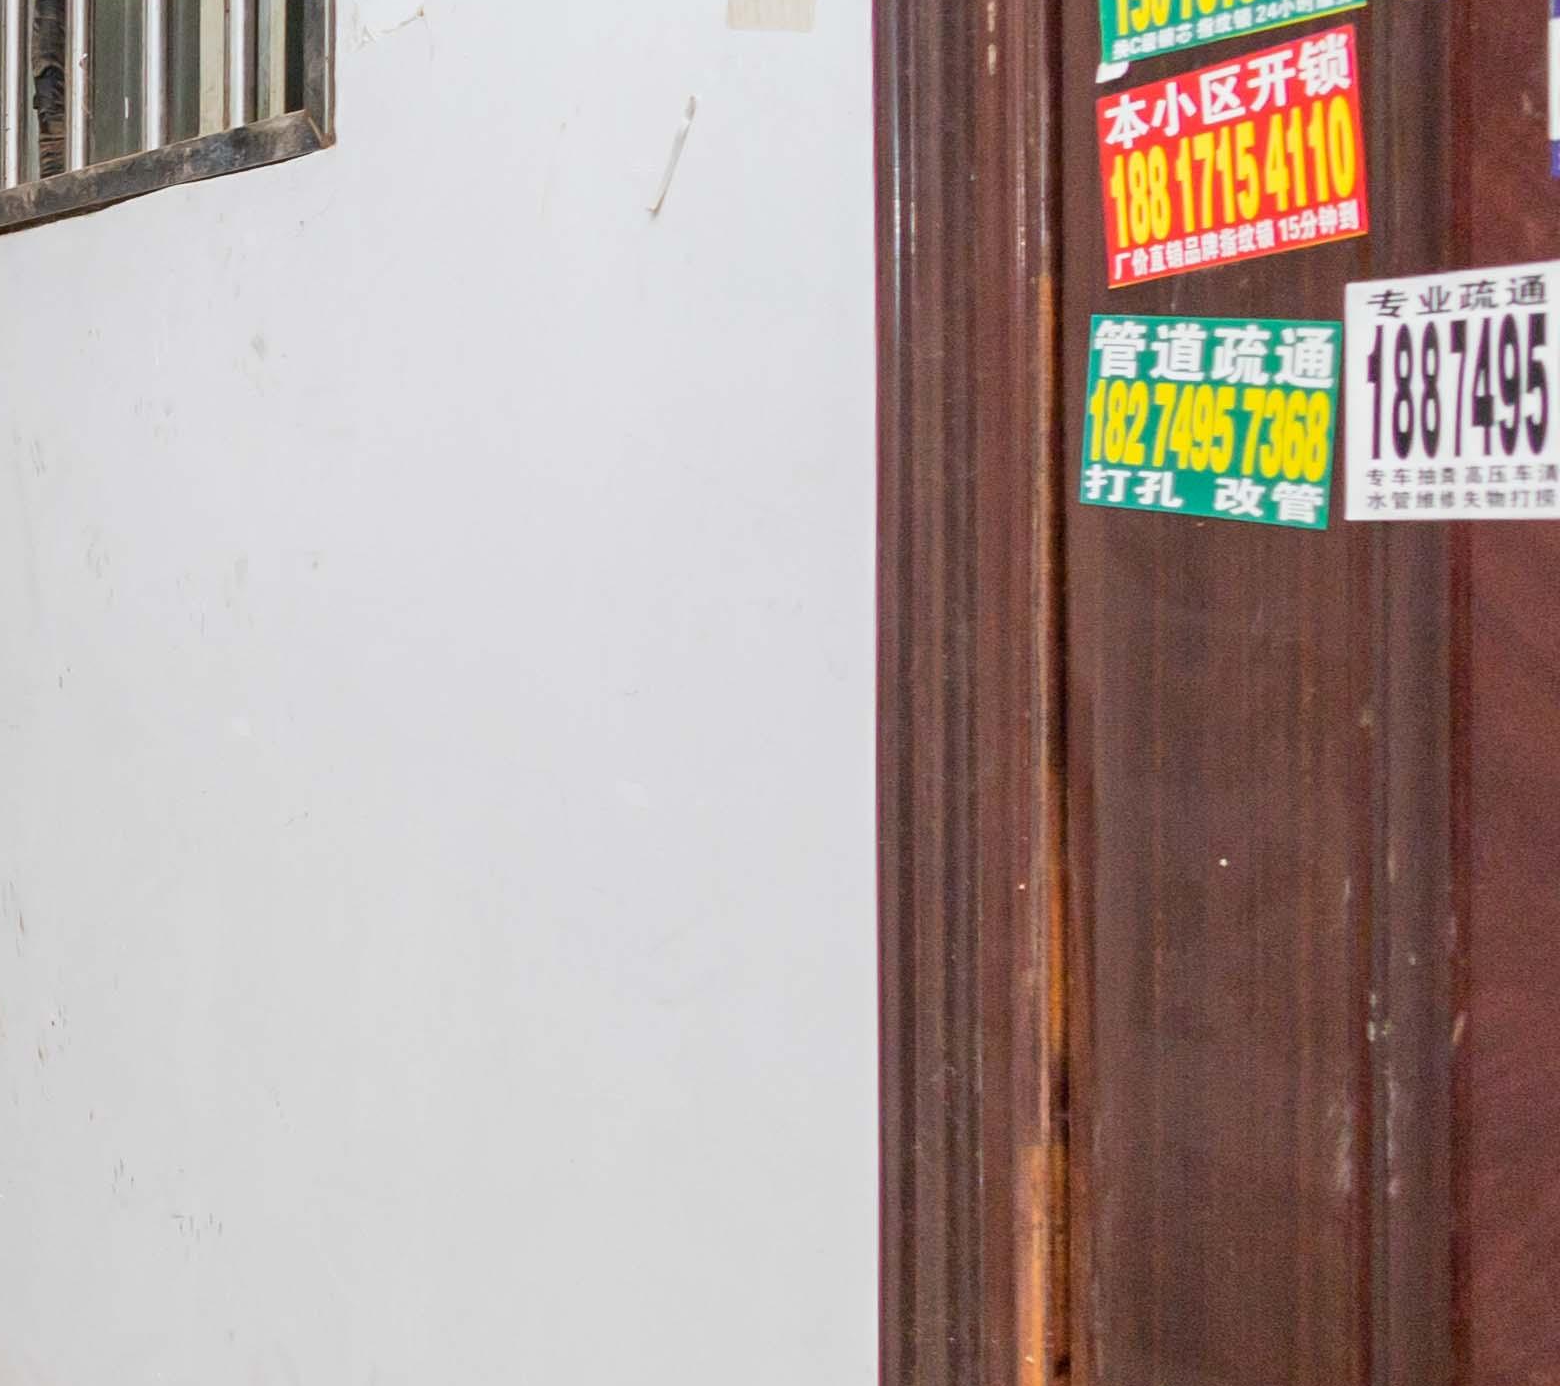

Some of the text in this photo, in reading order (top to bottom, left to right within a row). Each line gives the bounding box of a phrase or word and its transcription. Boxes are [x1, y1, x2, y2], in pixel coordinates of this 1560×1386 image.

[1103, 31, 1355, 150] 本小区开锁
[1108, 93, 1356, 250] 188 1715 4110
[1365, 272, 1550, 320] 专业疏通
[1093, 318, 1338, 390] 管道疏通
[1088, 378, 1332, 483] 182 7495 7368
[1083, 467, 1183, 510] 打孔
[1213, 475, 1325, 525] 改管
